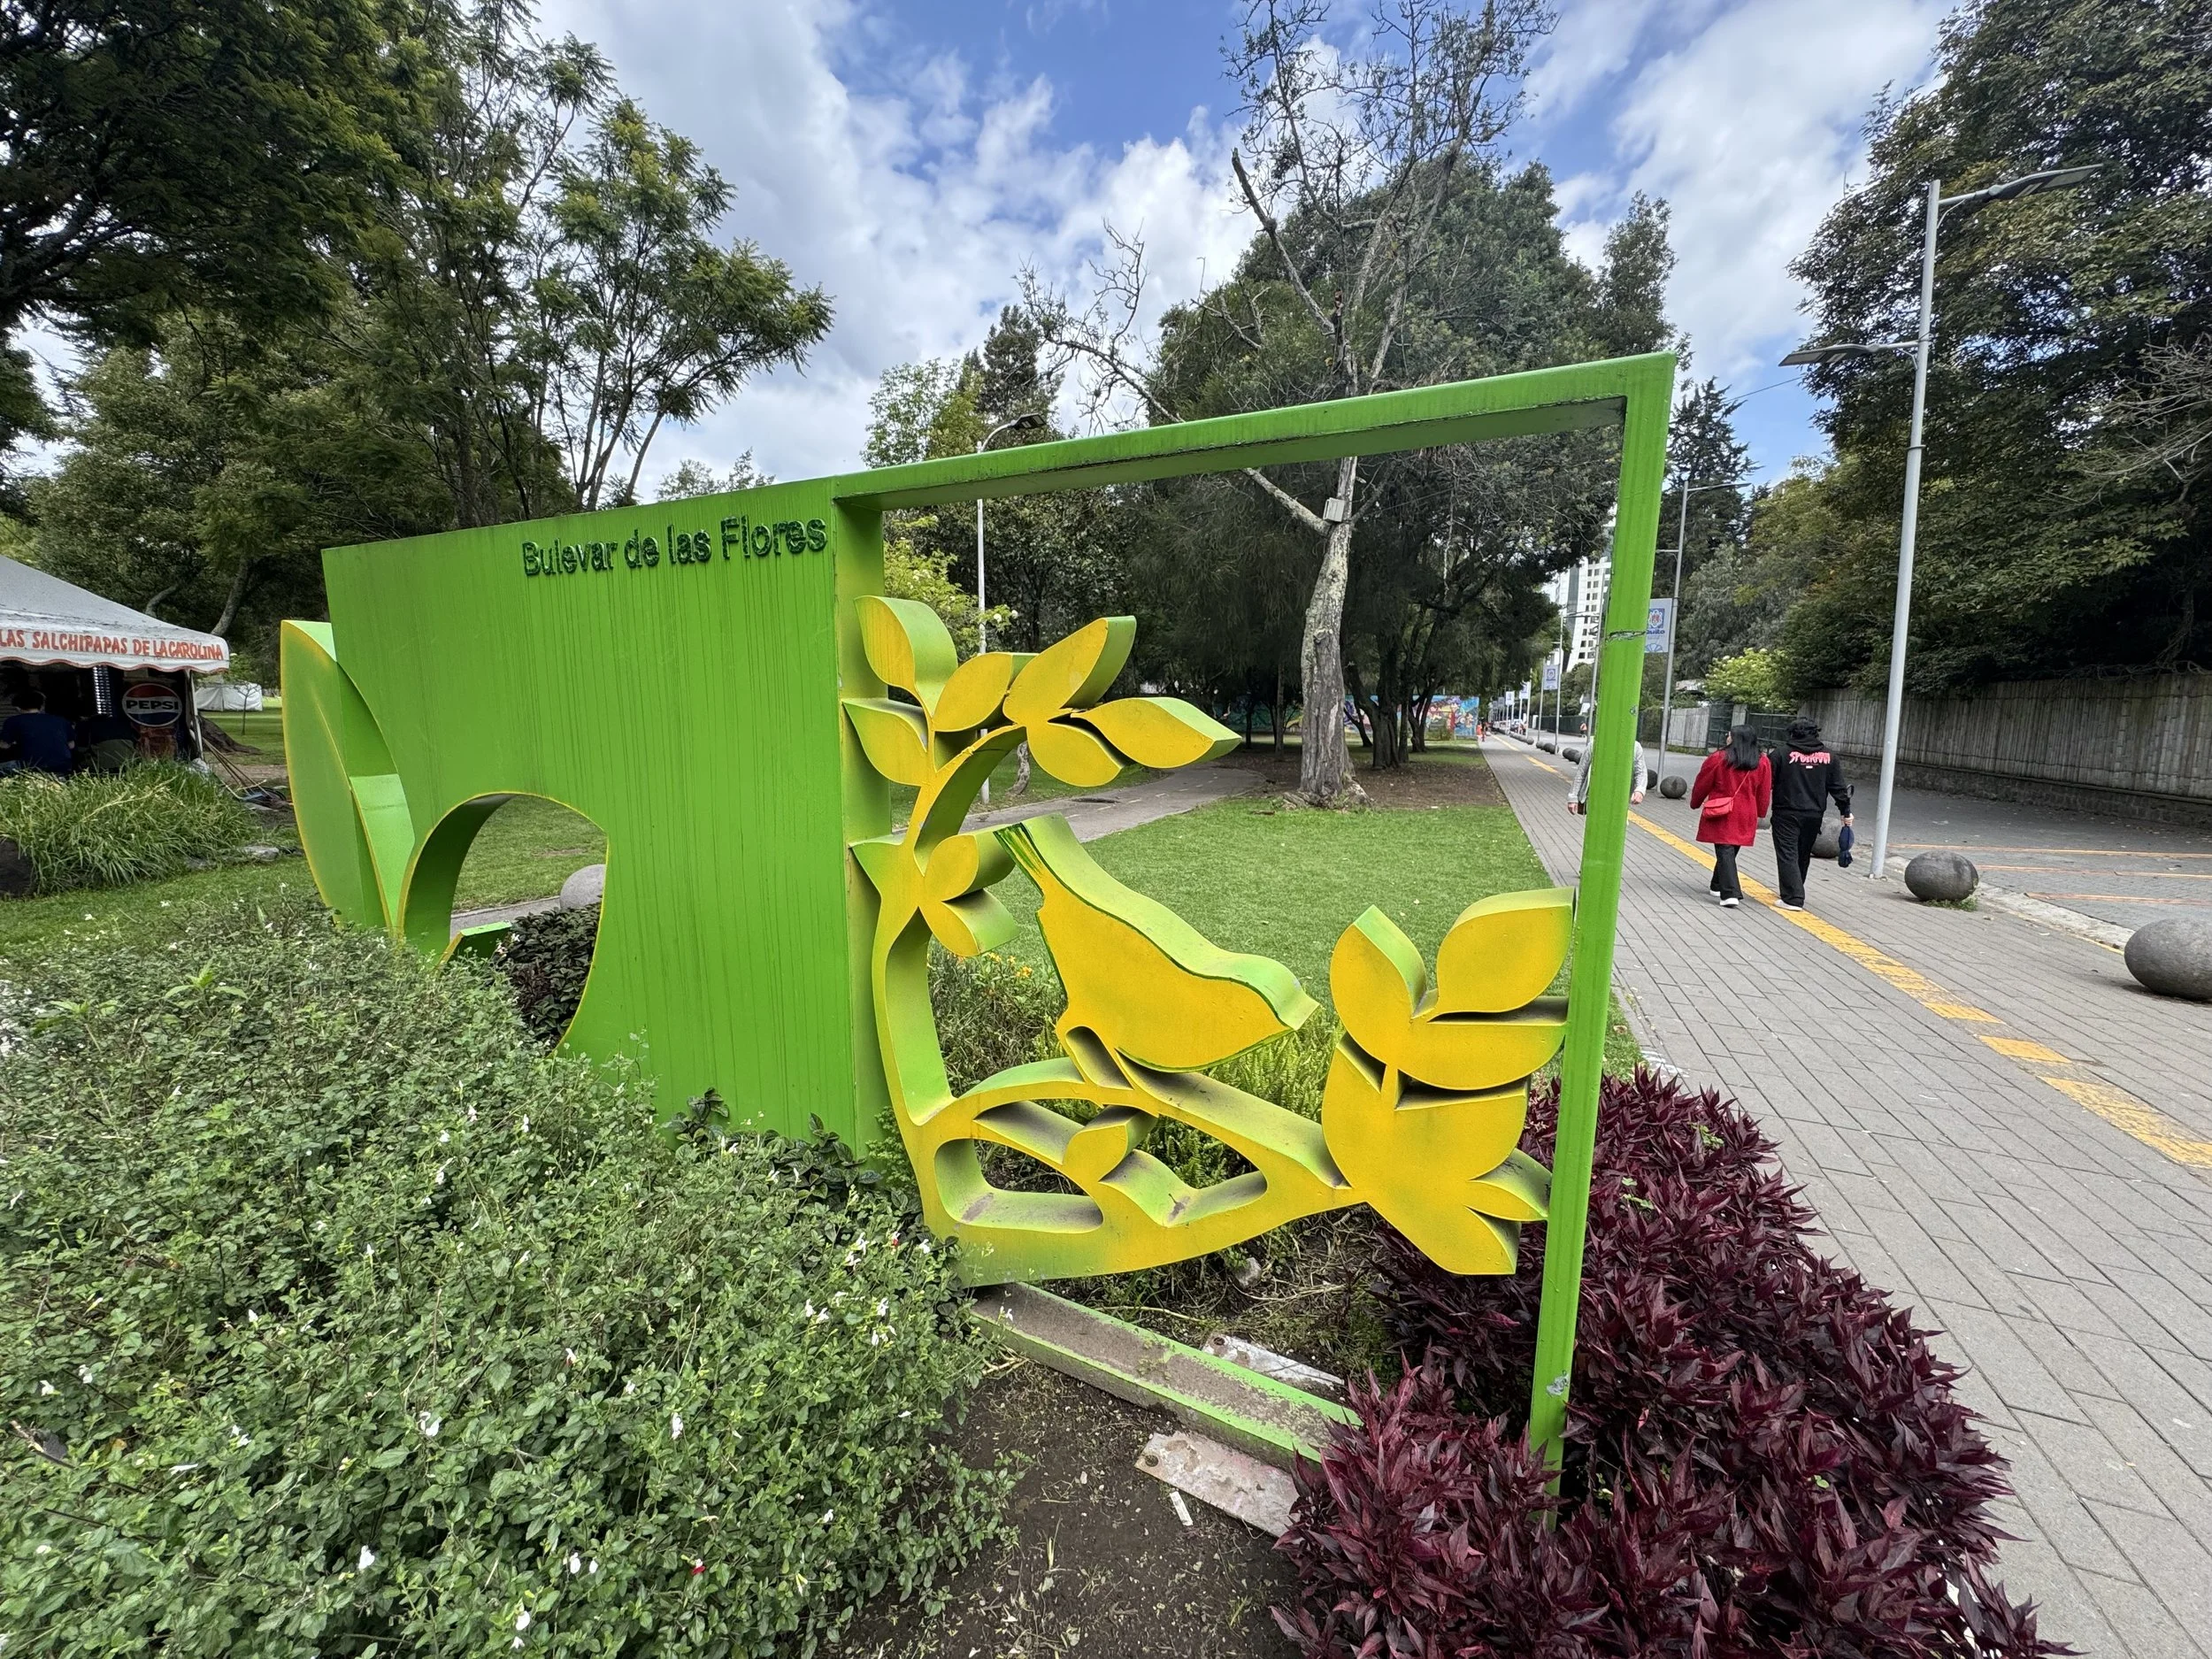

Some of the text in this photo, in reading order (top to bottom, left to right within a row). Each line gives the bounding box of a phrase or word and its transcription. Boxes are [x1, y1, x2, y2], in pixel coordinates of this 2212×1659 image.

[522, 514, 828, 576] Bulevar de las Flores
[0, 629, 26, 648] LAS
[32, 631, 128, 654] SALCHIPAPAS
[133, 639, 150, 656] DE
[126, 700, 180, 710] PEPSI
